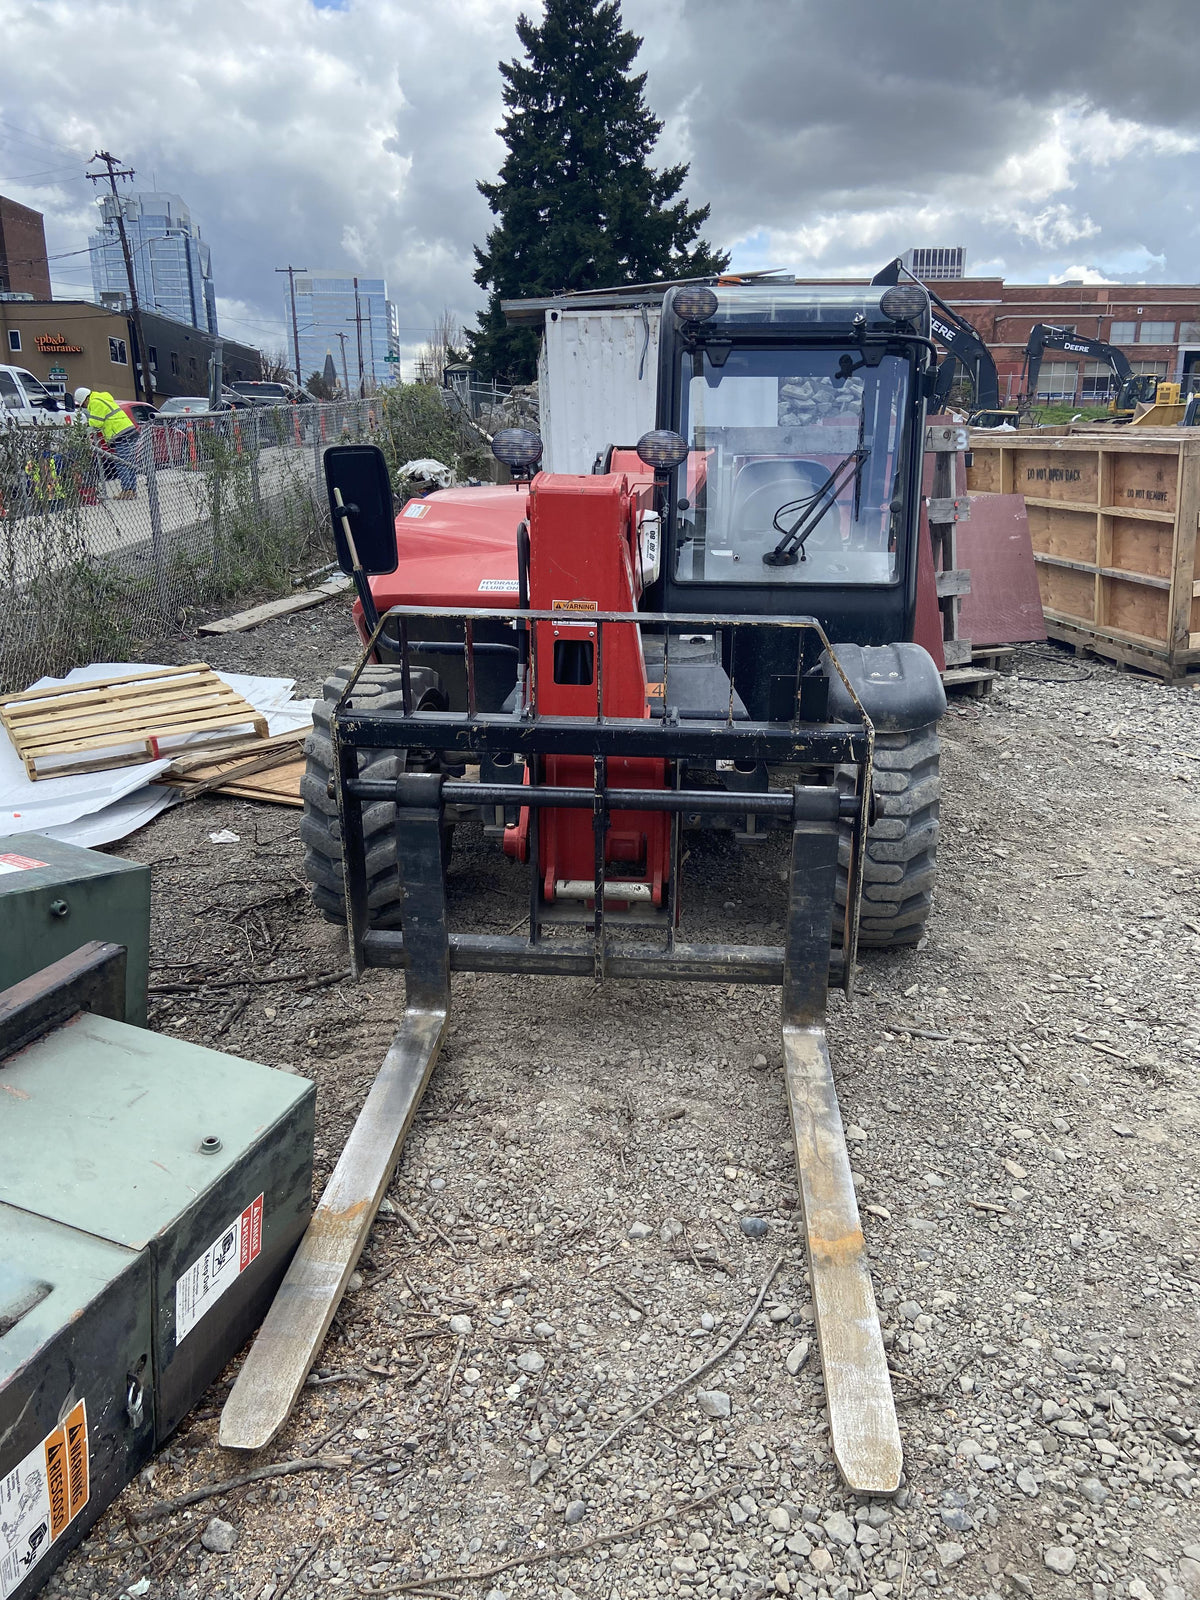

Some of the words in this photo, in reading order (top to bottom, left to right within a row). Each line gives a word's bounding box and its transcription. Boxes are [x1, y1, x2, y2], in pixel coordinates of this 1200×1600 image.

[931, 317, 956, 341] ERE
[37, 344, 81, 352] insurance
[1064, 342, 1090, 353] DEERE
[1027, 468, 1034, 480] DO
[1036, 468, 1046, 480] NOT
[1049, 468, 1064, 481] OPEN
[1127, 489, 1134, 497] DO
[1135, 489, 1145, 499] NOT
[1146, 490, 1168, 501] REMOVE
[241, 1225, 249, 1264] PELIGRO
[252, 1215, 260, 1252] DANGER
[202, 1252, 210, 1276] Keep
[202, 1275, 210, 1294] Out
[69, 1437, 83, 1506] WARNING
[49, 1459, 65, 1530] RIESGOSO
